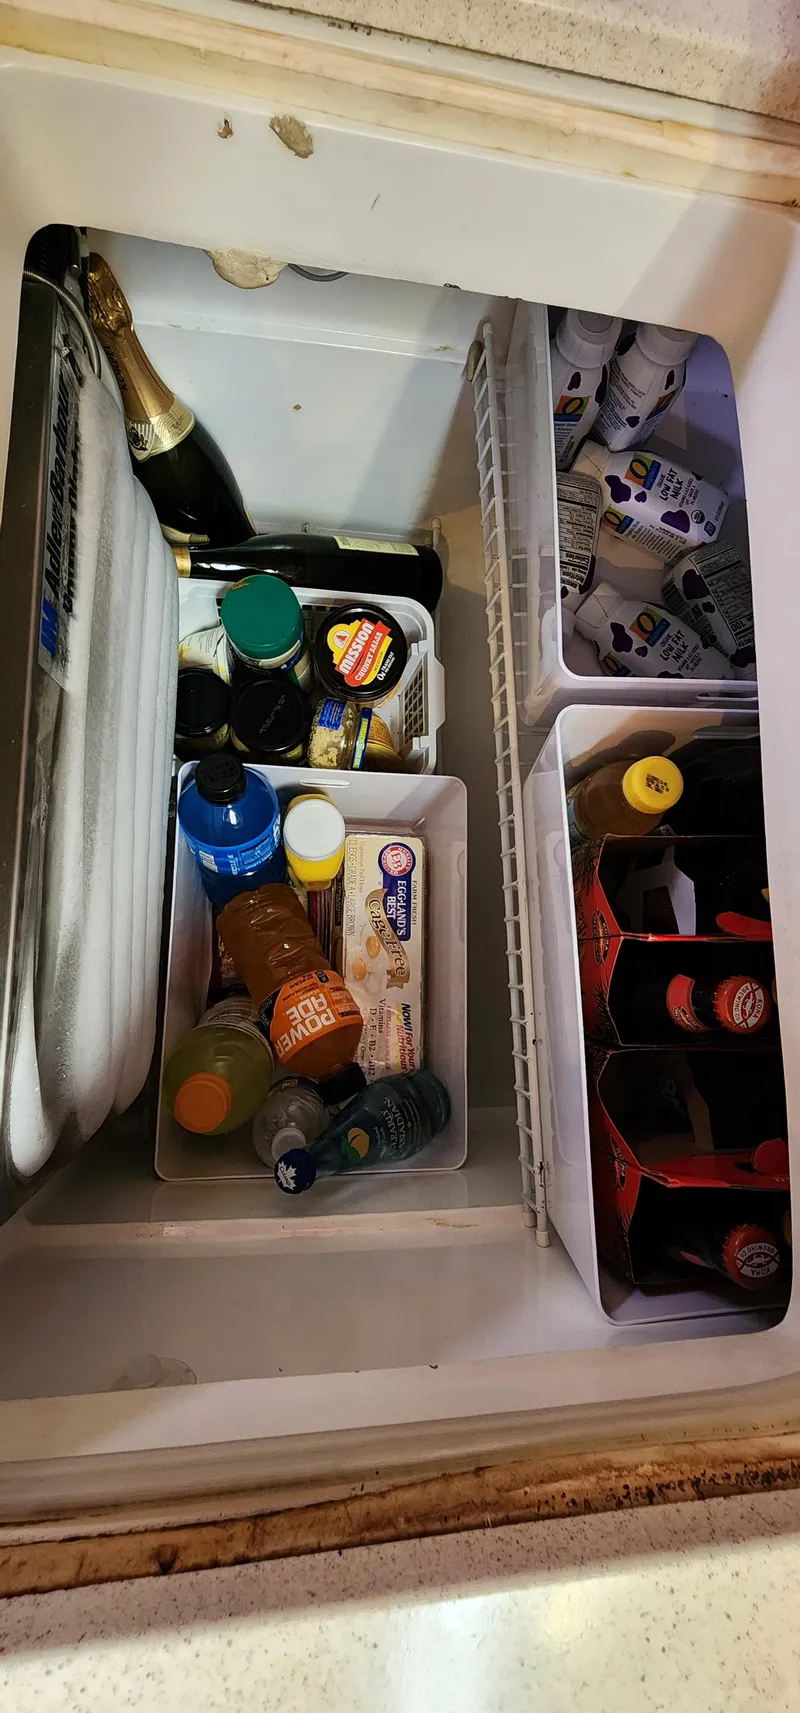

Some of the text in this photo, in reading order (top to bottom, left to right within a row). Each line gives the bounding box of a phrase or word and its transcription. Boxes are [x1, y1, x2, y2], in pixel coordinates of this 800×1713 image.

[659, 467, 678, 501] LOW FAT
[670, 478, 684, 500] MILK
[565, 553, 590, 564] Calories
[339, 622, 375, 674] MISSION
[355, 632, 383, 681] CHUNKY SALSA
[660, 630, 685, 661] LOW FAT
[672, 641, 689, 663] MILK
[374, 651, 384, 671] MEDIUM
[391, 850, 402, 869] EB
[347, 866, 356, 886] GRADE
[386, 895, 397, 920] BEST
[346, 914, 355, 936] BROWN
[367, 898, 406, 978] Cage Free
[285, 993, 328, 1026] ADE
[734, 985, 750, 1012] BREWING
[753, 998, 763, 1018] KONA
[370, 1008, 377, 1016] D
[378, 998, 386, 1033] Vitamins
[274, 1008, 337, 1058] POWER
[405, 1032, 414, 1048] For
[368, 1040, 377, 1051] B2
[396, 1024, 408, 1073] Nutritious
[368, 1061, 376, 1076] B12
[407, 1048, 416, 1072] Your
[747, 1244, 775, 1254] BREWING
[750, 1266, 771, 1276] KONA
